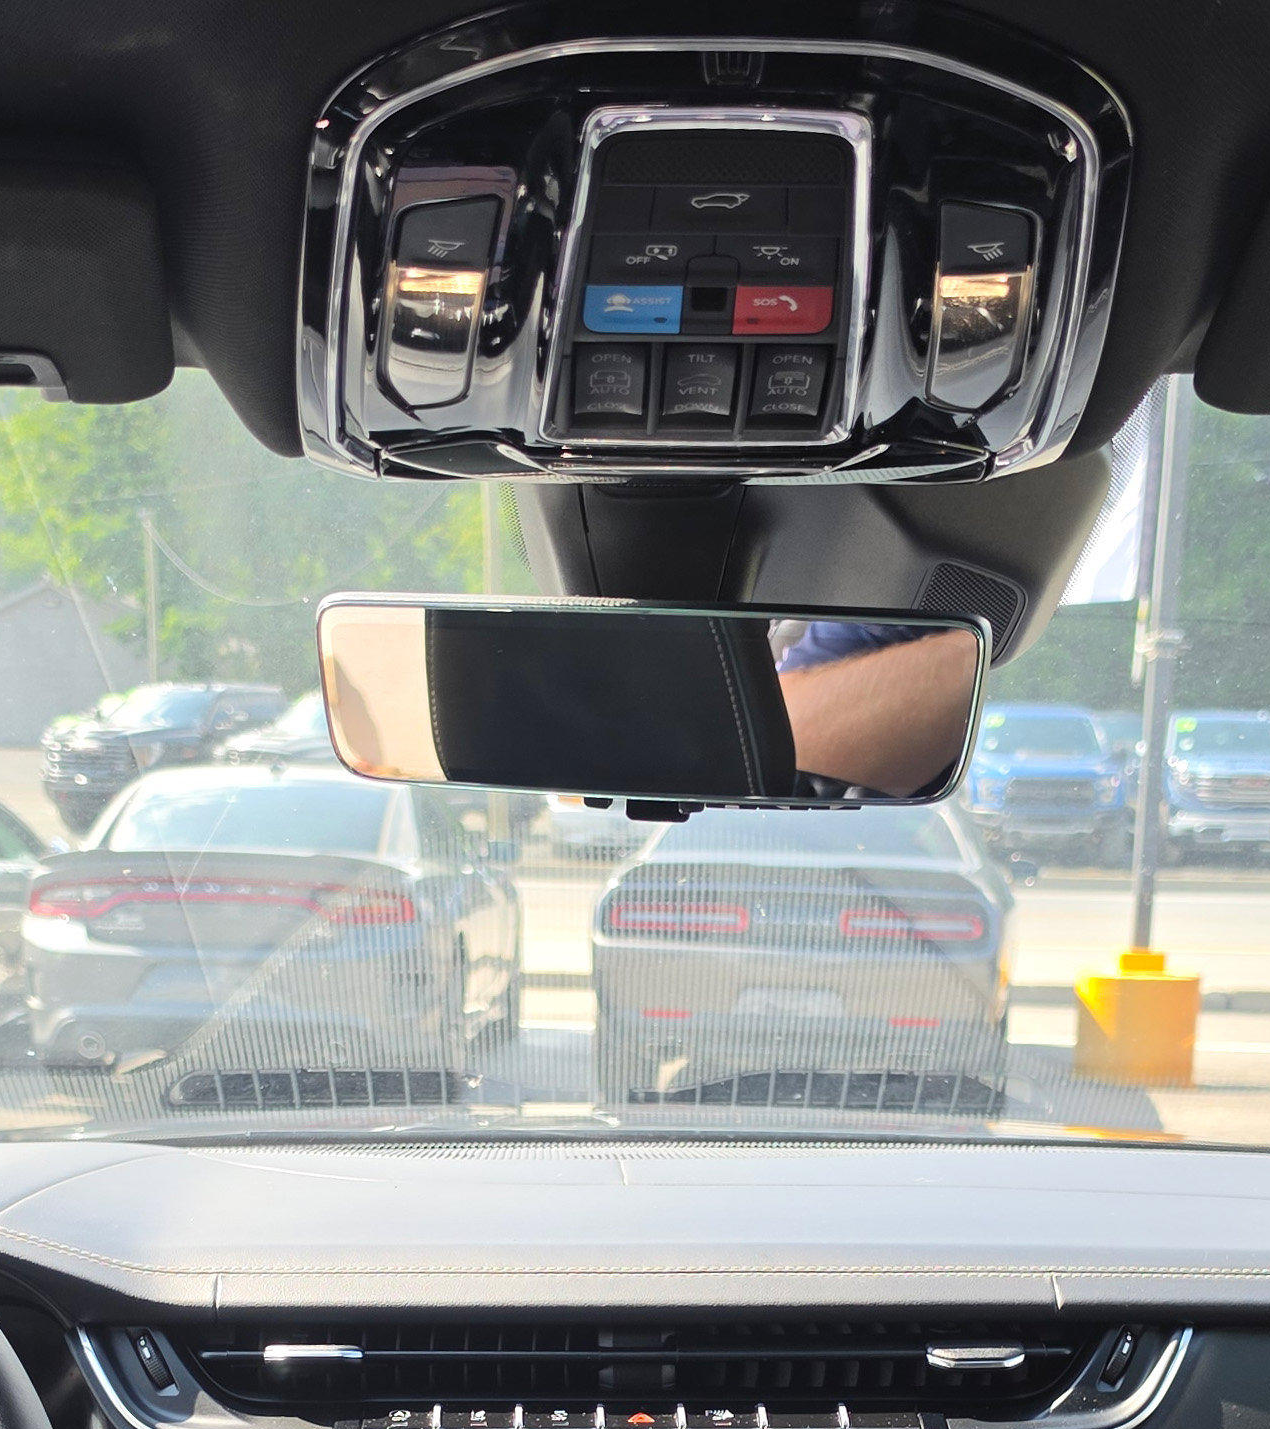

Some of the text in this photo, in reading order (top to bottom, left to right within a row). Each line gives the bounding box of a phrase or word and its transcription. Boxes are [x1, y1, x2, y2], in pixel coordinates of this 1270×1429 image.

[626, 256, 651, 265] OFF
[780, 257, 800, 266] ON
[631, 297, 672, 305] ASSIST
[753, 298, 778, 306] SOS
[591, 354, 632, 364] OPEN
[687, 354, 716, 363] TILT
[772, 355, 813, 365] OPEN
[589, 386, 630, 395] AUTO
[679, 387, 718, 396] VENT
[767, 387, 807, 396] AUTO
[762, 402, 804, 411] CLOSE
